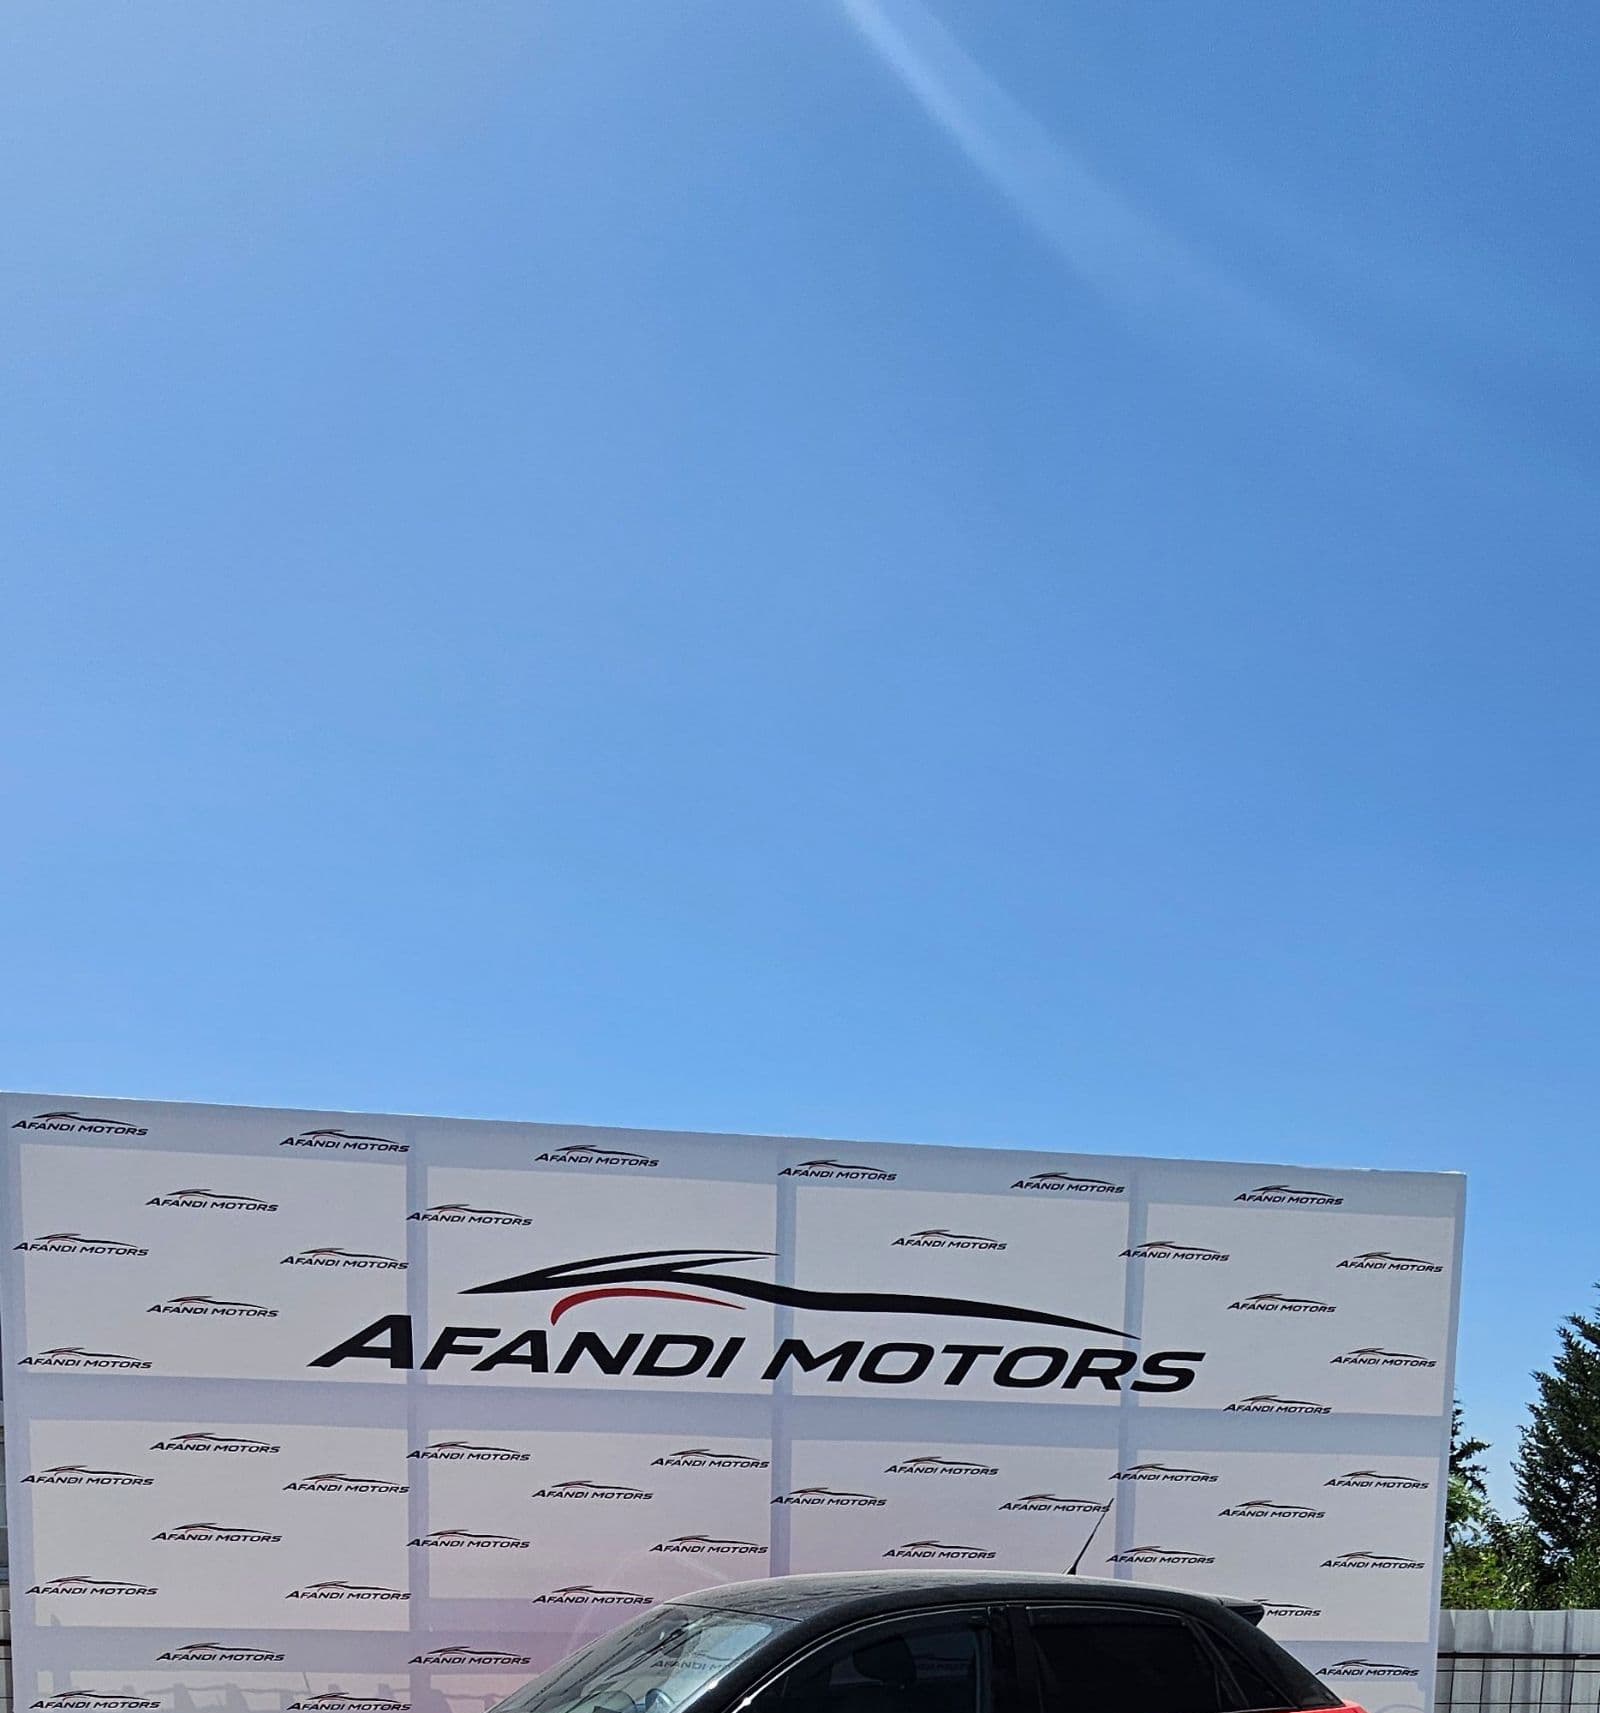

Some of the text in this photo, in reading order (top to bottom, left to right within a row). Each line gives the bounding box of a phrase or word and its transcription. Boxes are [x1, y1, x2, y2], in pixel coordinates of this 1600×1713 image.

[11, 1120, 148, 1136] AFANDI MOTORS
[279, 1137, 410, 1152] AFANDI MOTORS
[534, 1153, 659, 1167] AFANDI MOTORS
[777, 1168, 897, 1181] AFANDI MOTORS
[1010, 1180, 1125, 1193] AFANDI MOTORS
[146, 1196, 279, 1212] AFANDI MOTORS
[1234, 1193, 1344, 1205] AFANDI MOTORS
[406, 1212, 533, 1226] AFANDI MOTORS
[13, 1242, 149, 1256] AFANDI MOTORS
[891, 1238, 1007, 1250] AFANDI MOTORS
[1118, 1249, 1230, 1261] AFANDI MOTORS
[280, 1256, 409, 1270] AFANDI MOTORS
[1336, 1260, 1443, 1272] AFANDI MOTORS
[146, 1304, 279, 1317] AFANDI MOTORS
[1227, 1302, 1279, 1311] AFANDI
[307, 1314, 1206, 1392] AFANDI MOTORS
[17, 1357, 152, 1369] AFANDI MOTORS
[1330, 1356, 1437, 1367] AFANDI MOTORS
[1223, 1404, 1332, 1414] AFANDI MOTORS
[150, 1440, 280, 1453] AFANDI MOTORS
[406, 1449, 531, 1461] AFANDI MOTORS
[650, 1458, 770, 1468] AFANDI MOTORS
[884, 1465, 999, 1475] AFANDI MOTORS
[20, 1475, 83, 1484] AFANDI
[1108, 1472, 1161, 1480] AFANDI
[282, 1483, 410, 1493] AFANDI MOTORS
[1324, 1479, 1429, 1489] AFANDI MOTORS
[532, 1489, 653, 1500] AFANDI MOTORS
[770, 1496, 887, 1506] AFANDI MOTORS
[998, 1502, 1110, 1513] AFANDI MOTORS
[1218, 1509, 1269, 1517] AFANDI
[151, 1532, 213, 1541] AFANDI
[406, 1538, 465, 1547] AFANDI
[649, 1544, 706, 1553] AFANDI
[882, 1549, 936, 1558] AFANDI
[1106, 1554, 1157, 1563] AFANDI
[1320, 1560, 1369, 1568] AFANDI
[25, 1586, 88, 1594] AFANDI
[285, 1591, 344, 1599] AFANDI
[532, 1595, 589, 1603] AFANDI
[1266, 1609, 1321, 1617] MOTORS
[156, 1652, 217, 1661] AFANDI
[408, 1656, 466, 1664] AFANDI
[1315, 1668, 1364, 1676] AFANDI
[29, 1699, 91, 1708] AFANDI
[286, 1702, 345, 1711] AFANDI
